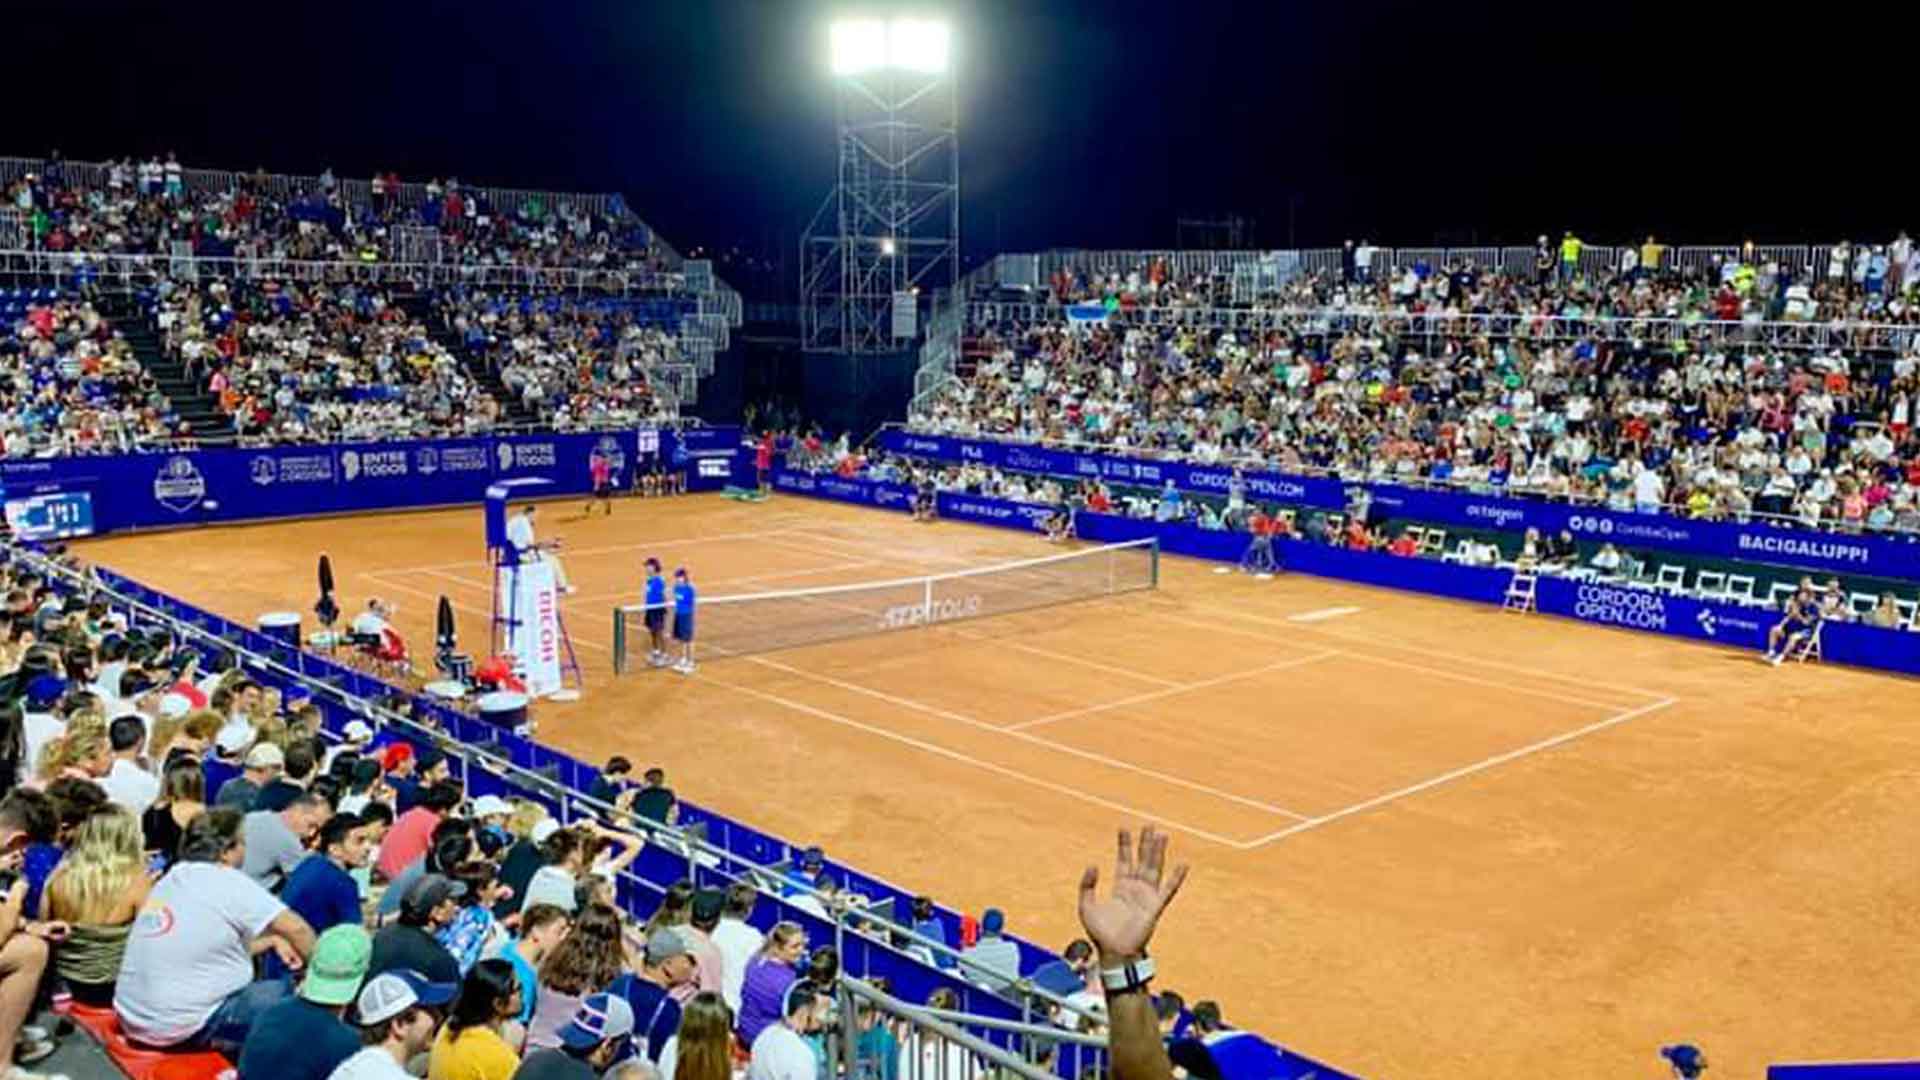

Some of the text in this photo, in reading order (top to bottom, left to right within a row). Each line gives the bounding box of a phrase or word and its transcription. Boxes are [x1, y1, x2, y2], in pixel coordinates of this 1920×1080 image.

[362, 451, 407, 466] ENTRE
[362, 463, 409, 477] TODOS
[1189, 472, 1305, 498] CORDOOPEN.COM
[1738, 534, 1869, 563] BACIGALUPPI
[1577, 585, 1665, 613] CORDOBA
[1575, 601, 1667, 630] OPEN.COM
